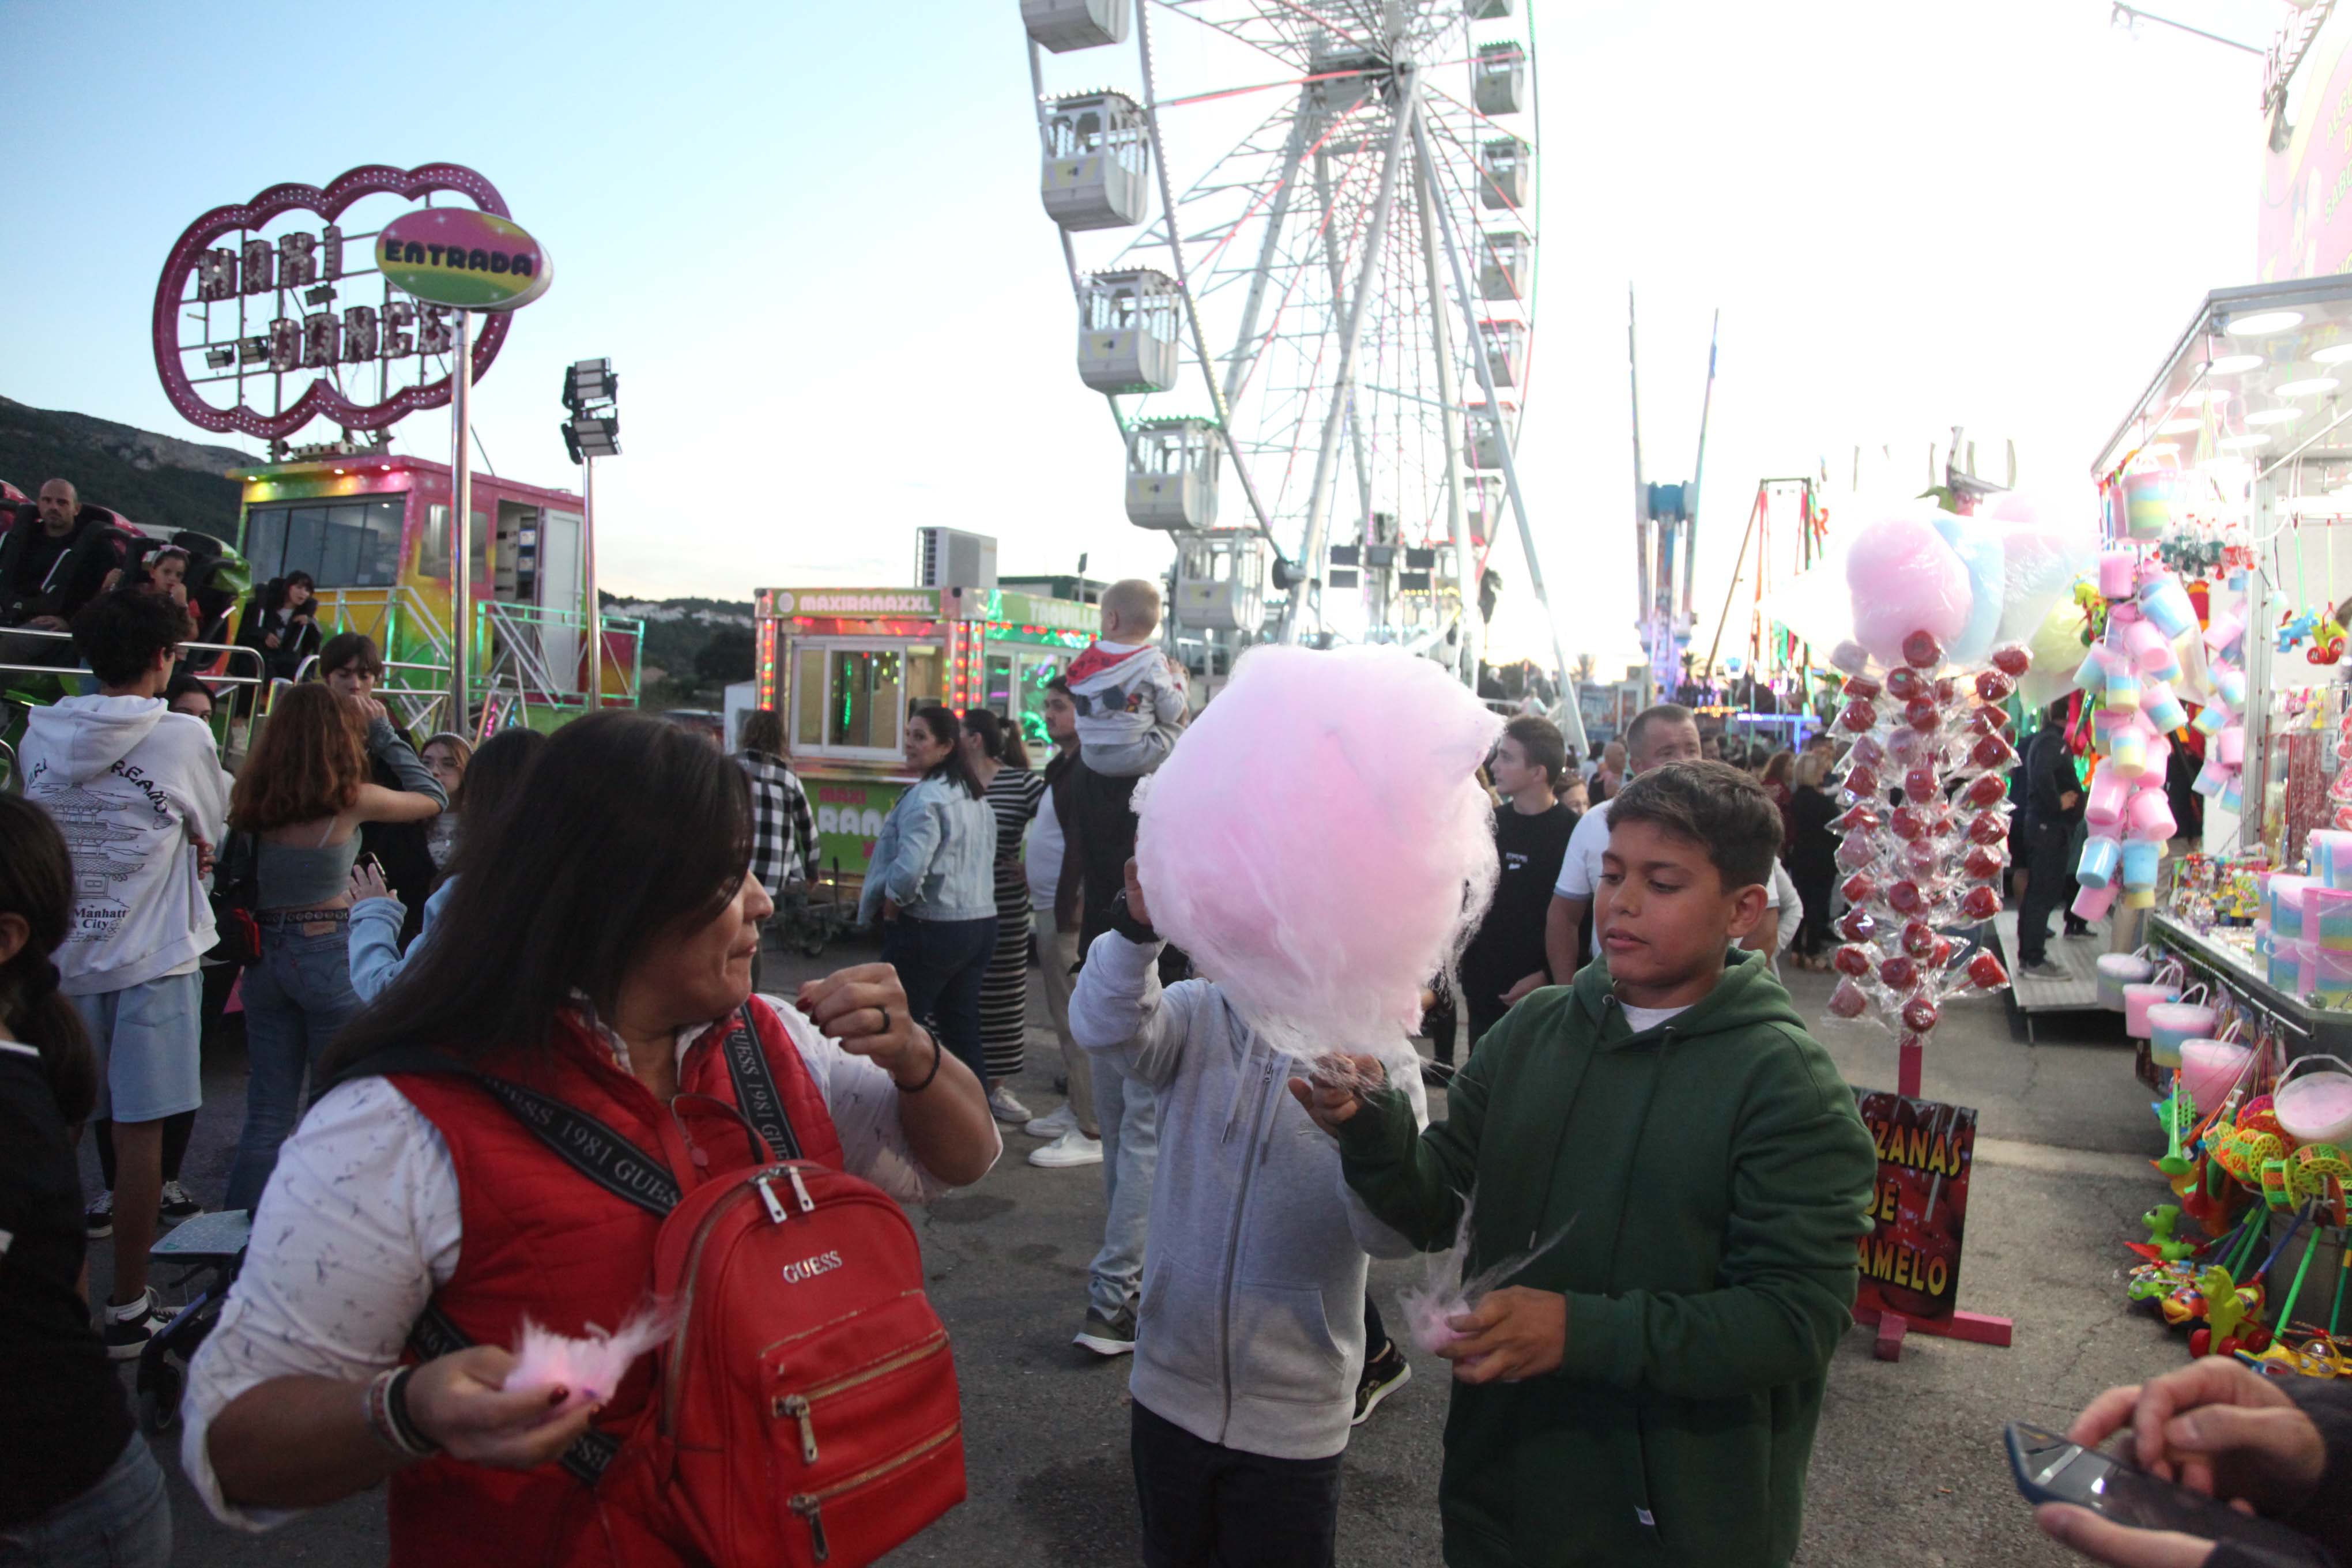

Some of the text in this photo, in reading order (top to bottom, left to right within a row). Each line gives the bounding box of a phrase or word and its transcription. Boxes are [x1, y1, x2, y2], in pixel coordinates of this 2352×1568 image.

[385, 239, 533, 277] ENTRADA
[819, 786, 867, 804] MAXI
[818, 805, 891, 837] RAN
[74, 908, 127, 918] Manhatt
[82, 919, 108, 930] City
[731, 1029, 760, 1075] UESS
[748, 1083, 774, 1117] 1981
[560, 1120, 613, 1165] 1981
[615, 1159, 679, 1206] GUES
[1868, 1120, 1963, 1177] ZANAS
[783, 1250, 843, 1283] GUESS
[1858, 1235, 1947, 1296] AMELO
